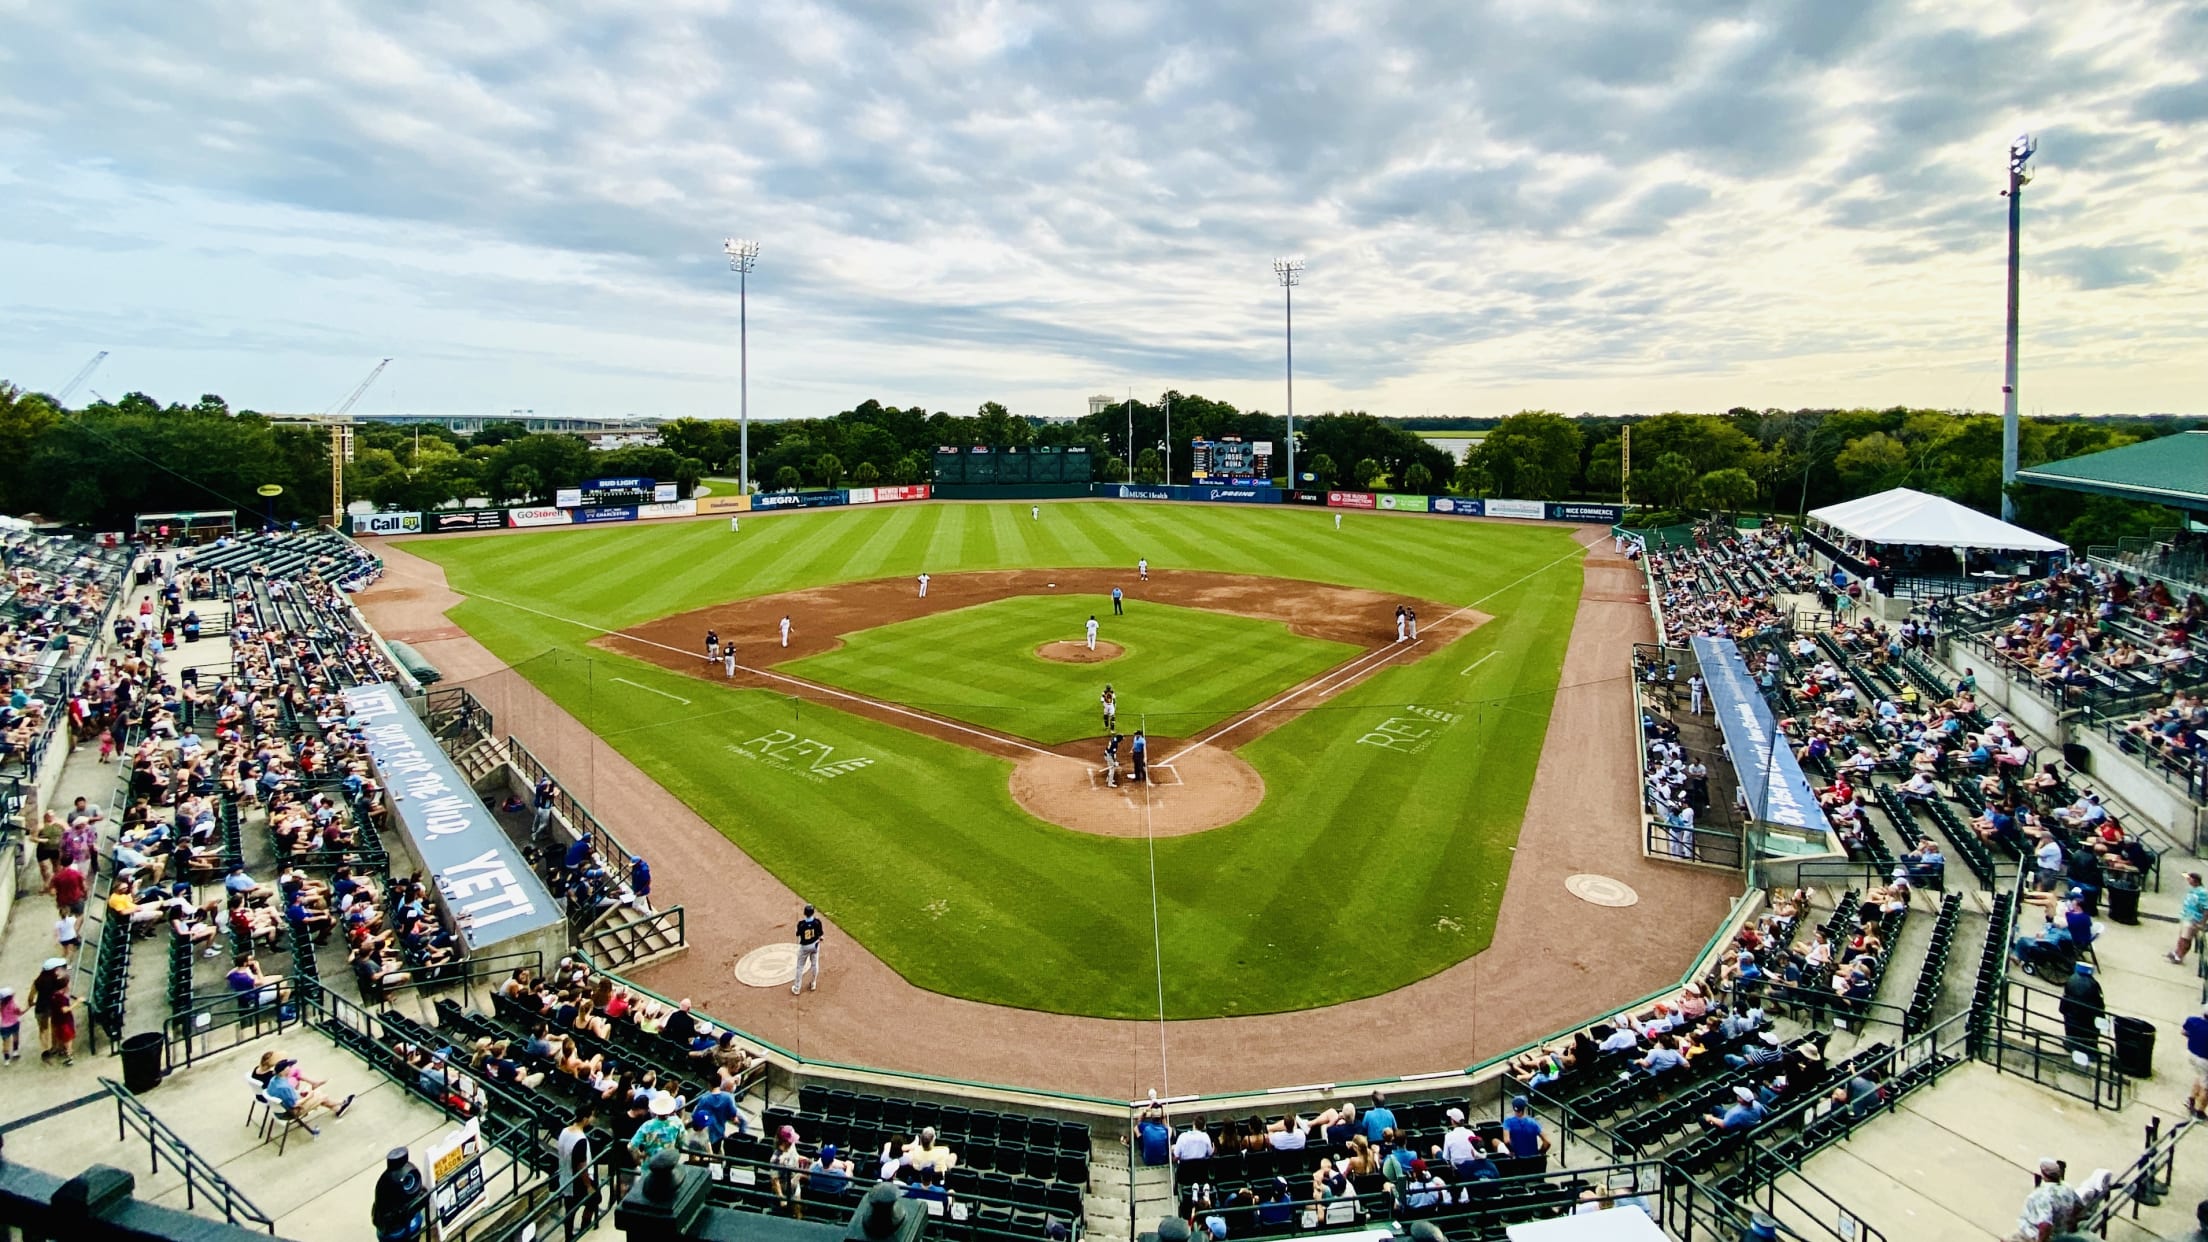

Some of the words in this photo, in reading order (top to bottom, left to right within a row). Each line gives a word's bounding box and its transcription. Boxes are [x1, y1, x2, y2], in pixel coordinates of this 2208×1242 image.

[762, 496, 800, 505] SEGRA
[1149, 491, 1168, 499] Health
[371, 517, 399, 530] Call
[345, 689, 398, 722] YETI
[367, 723, 415, 750] BUILT
[383, 750, 434, 775] FOR
[404, 771, 452, 800] THE
[443, 849, 535, 928] YETI
